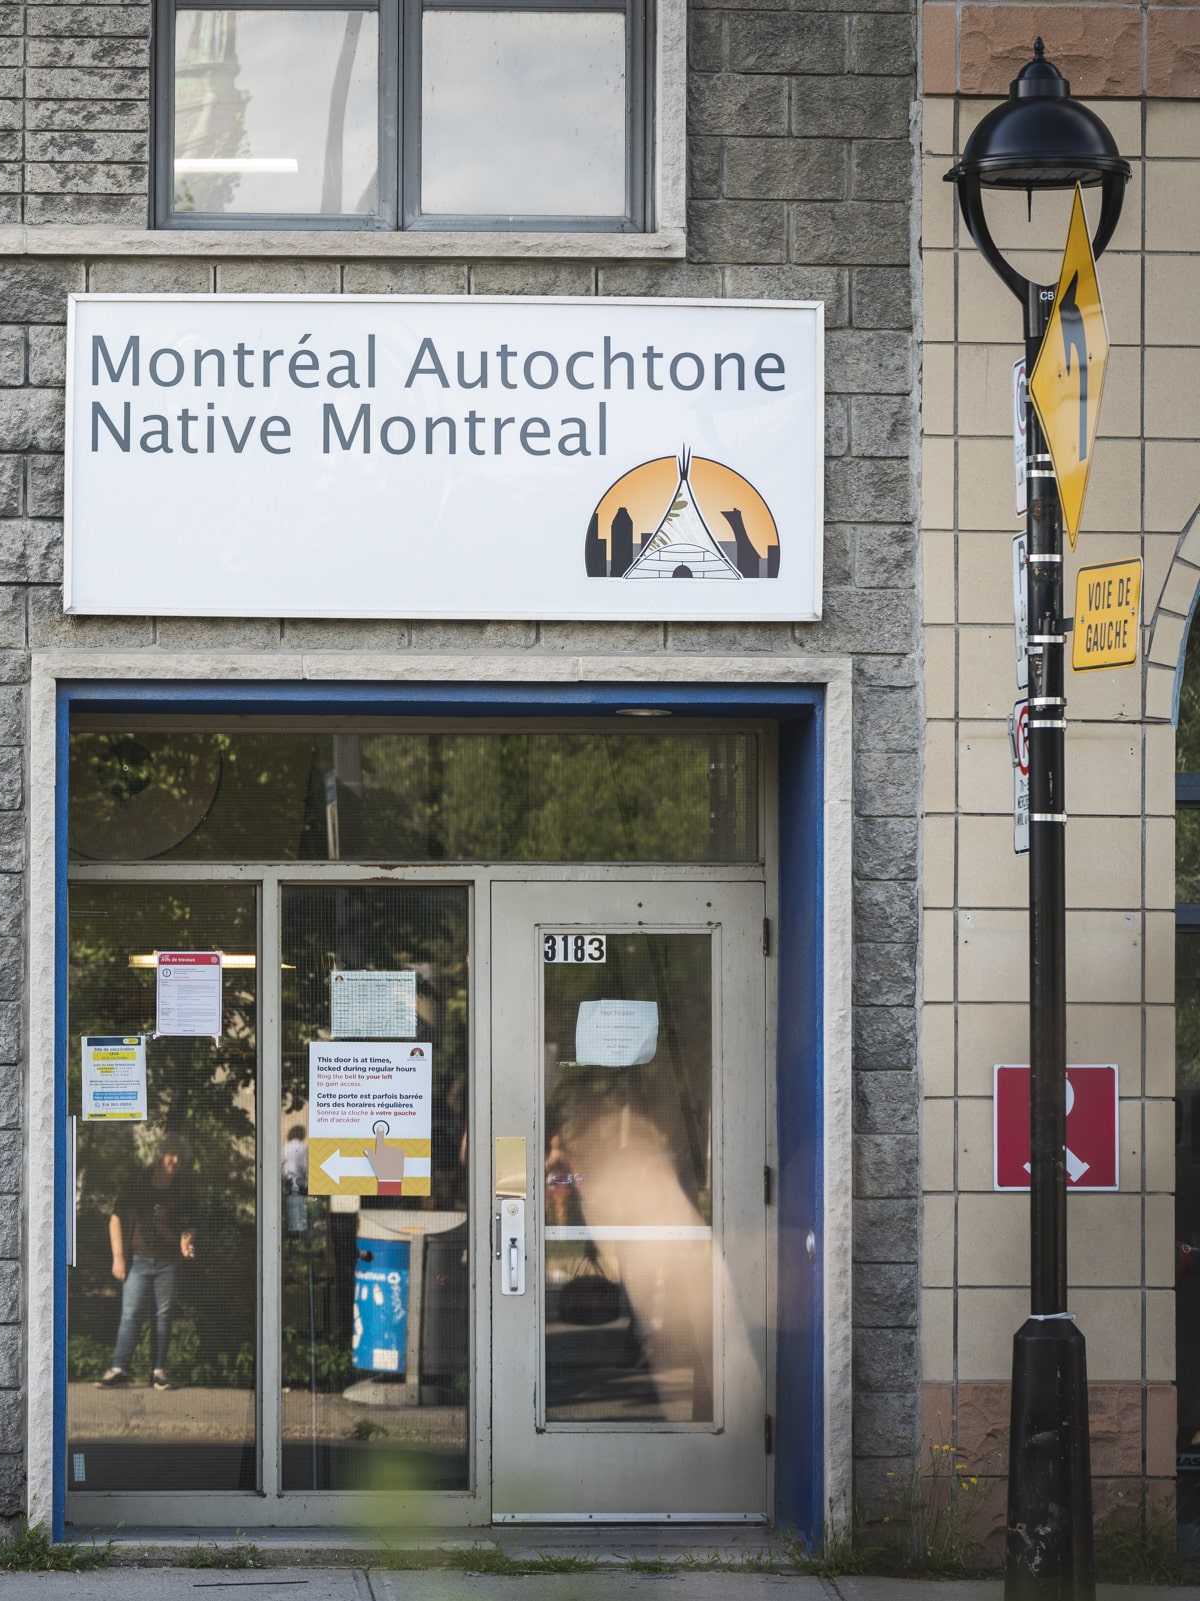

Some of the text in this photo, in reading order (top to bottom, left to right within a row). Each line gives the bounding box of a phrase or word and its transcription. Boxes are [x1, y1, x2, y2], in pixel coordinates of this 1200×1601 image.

[91, 333, 787, 393] Montréal Autochtone
[91, 401, 608, 457] Native Montreal
[1088, 577, 1131, 612] VOIE DE
[1086, 619, 1128, 653] GAUCHE
[544, 935, 604, 962] 3183
